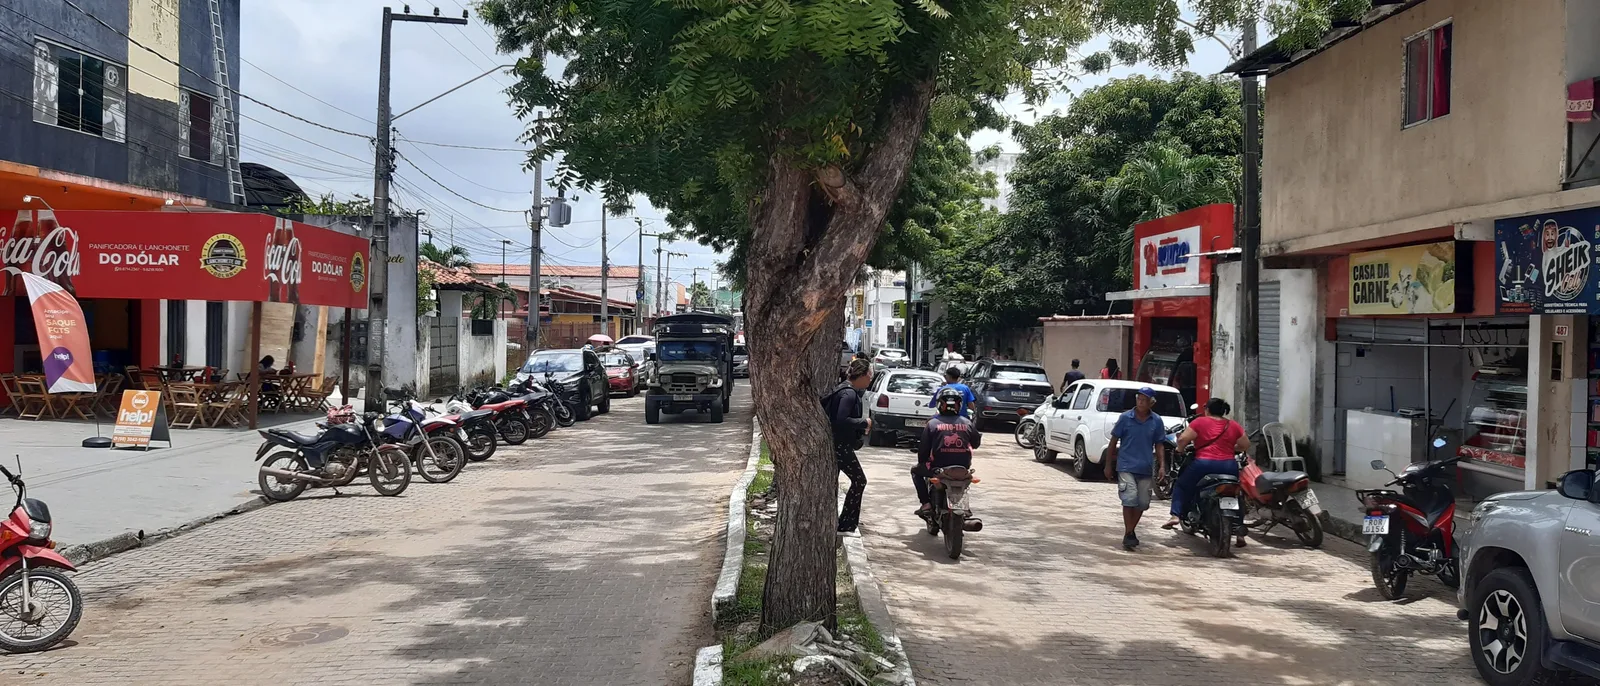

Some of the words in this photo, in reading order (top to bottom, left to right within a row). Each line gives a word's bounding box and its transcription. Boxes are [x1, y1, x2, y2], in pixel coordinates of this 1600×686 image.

[99, 253, 121, 264] DO
[125, 250, 179, 266] DÓLAR
[264, 233, 302, 284] Coca-Col
[312, 260, 322, 273] DO
[323, 260, 344, 277] DÓLAR
[1353, 264, 1376, 281] CASA
[1377, 263, 1390, 279] DA
[1545, 244, 1589, 294] SHEIK
[1353, 281, 1390, 304] CARNE
[46, 319, 76, 327] SAQUE
[1556, 326, 1568, 335] 487
[120, 408, 153, 425] help!
